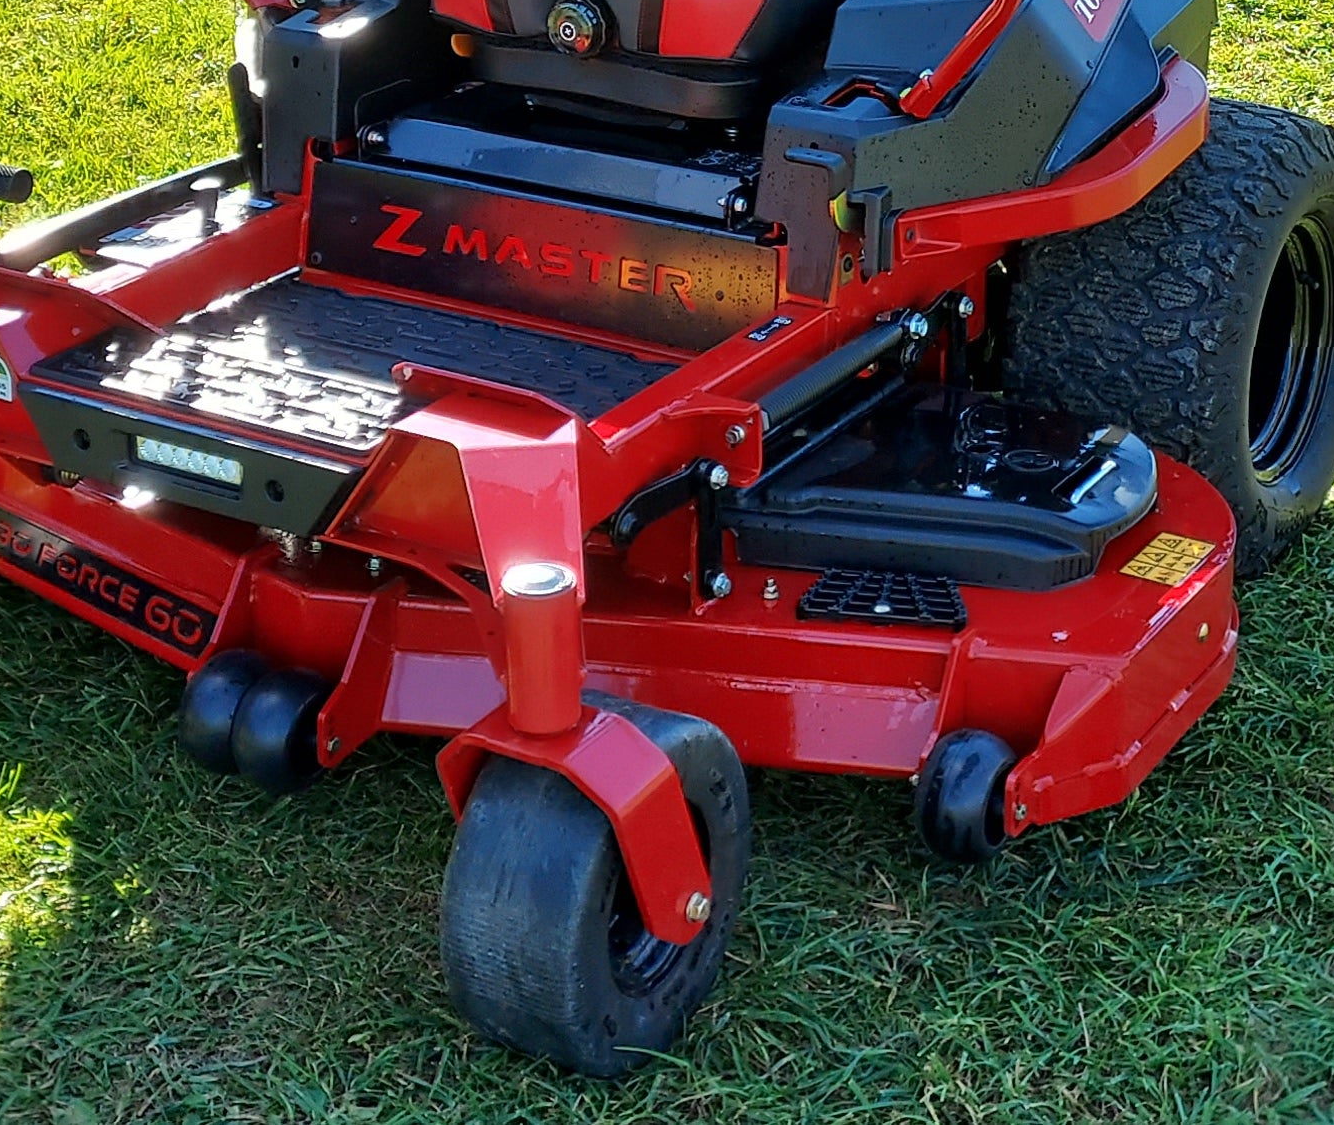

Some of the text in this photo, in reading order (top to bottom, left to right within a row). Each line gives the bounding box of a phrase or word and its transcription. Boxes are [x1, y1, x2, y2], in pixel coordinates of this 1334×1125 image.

[372, 204, 696, 312] Z MASTER
[38, 542, 140, 613] FORCE
[145, 595, 203, 646] 60
